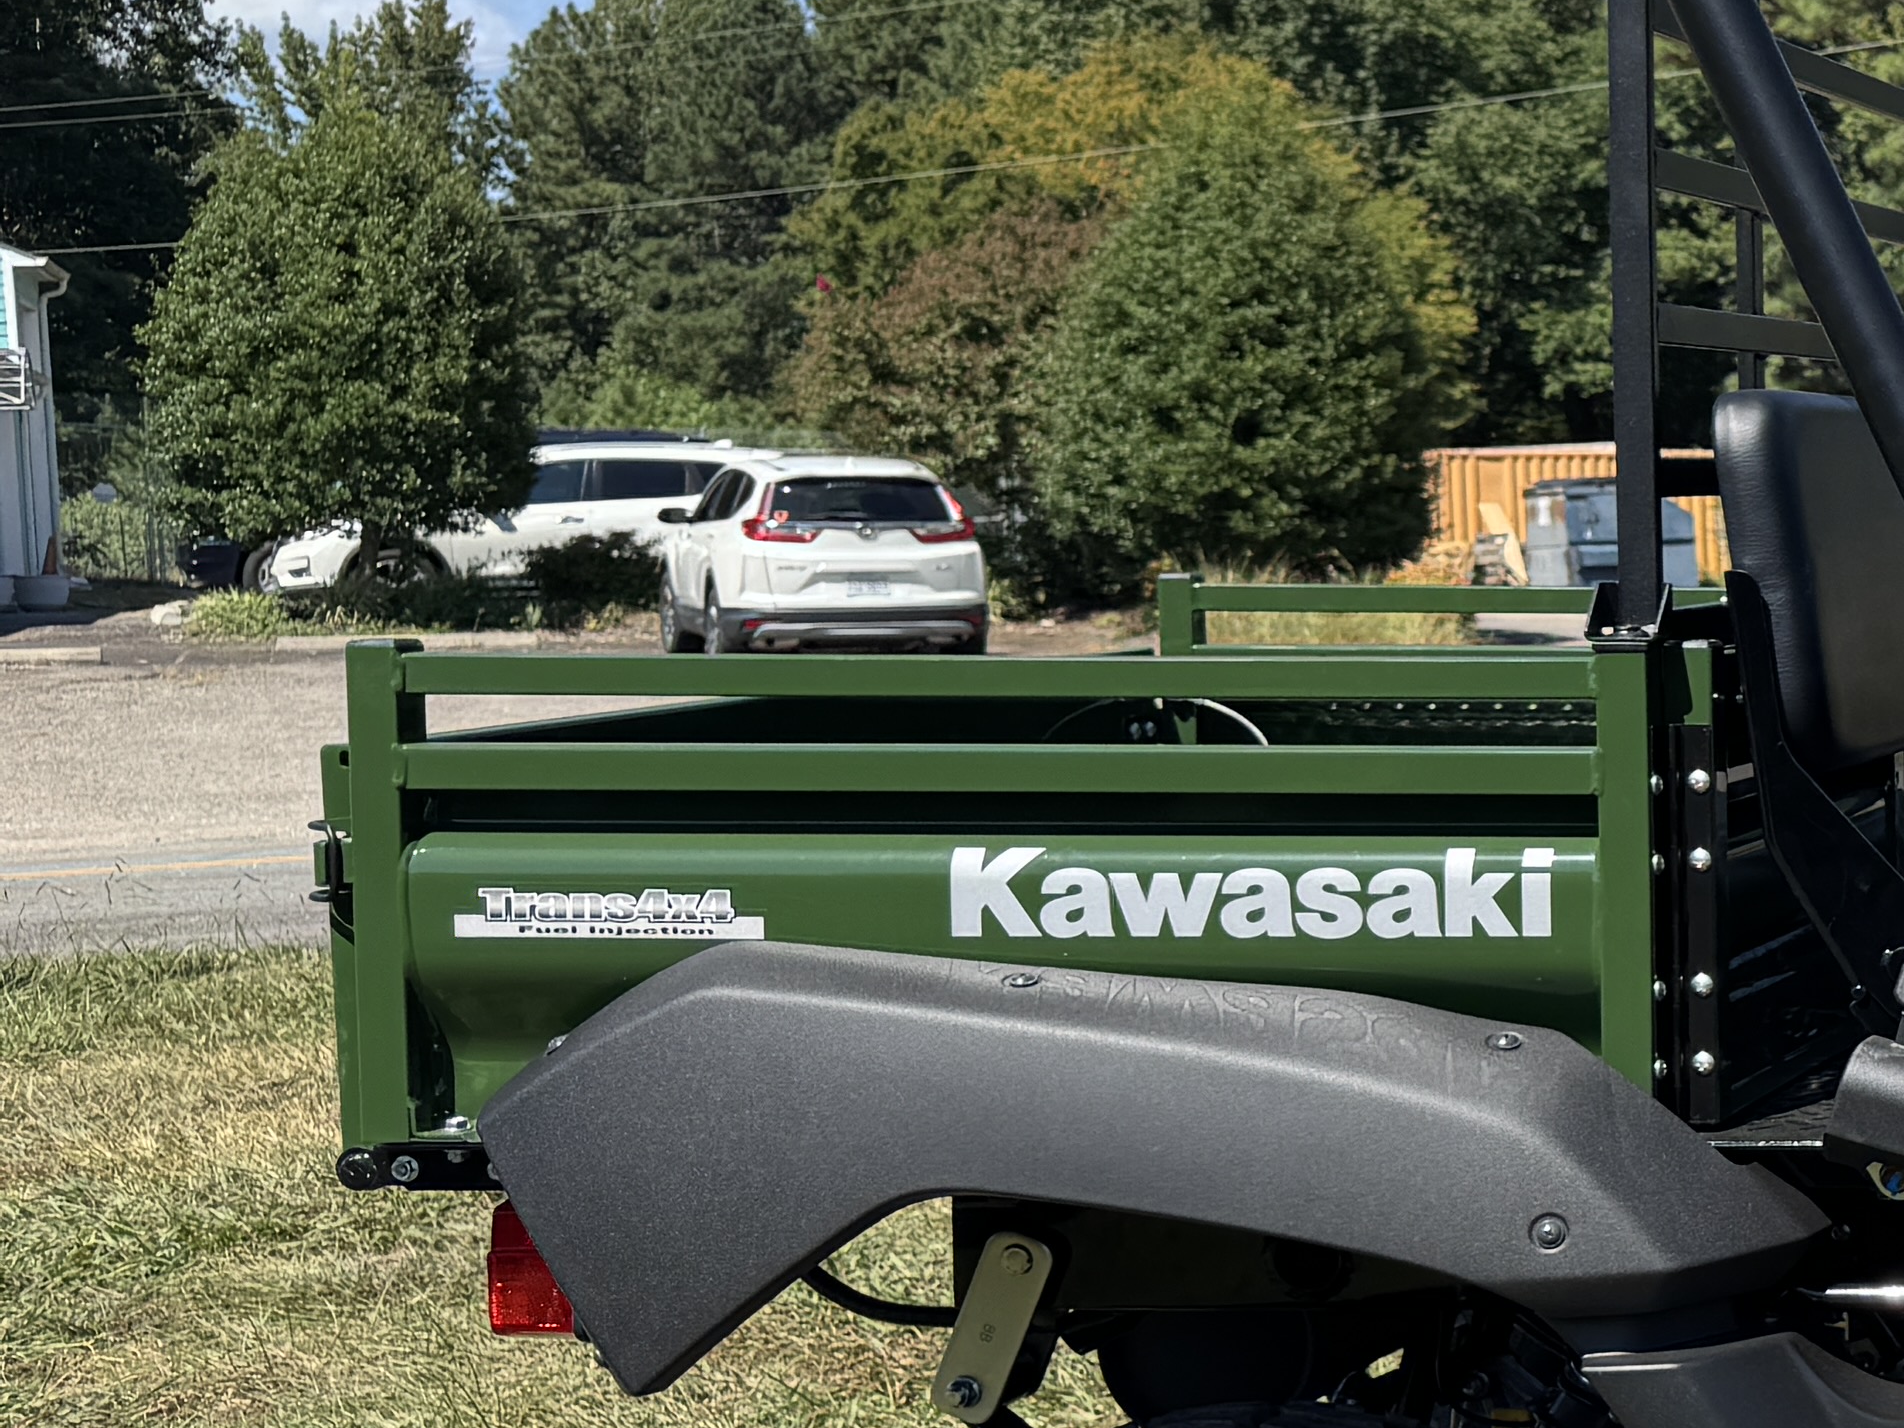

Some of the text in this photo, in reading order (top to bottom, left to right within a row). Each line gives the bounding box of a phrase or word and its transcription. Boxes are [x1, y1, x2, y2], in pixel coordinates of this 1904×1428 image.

[478, 888, 735, 922] Trans4x4
[951, 846, 1556, 940] Kawasaki
[518, 925, 714, 936] Fuel Injection
